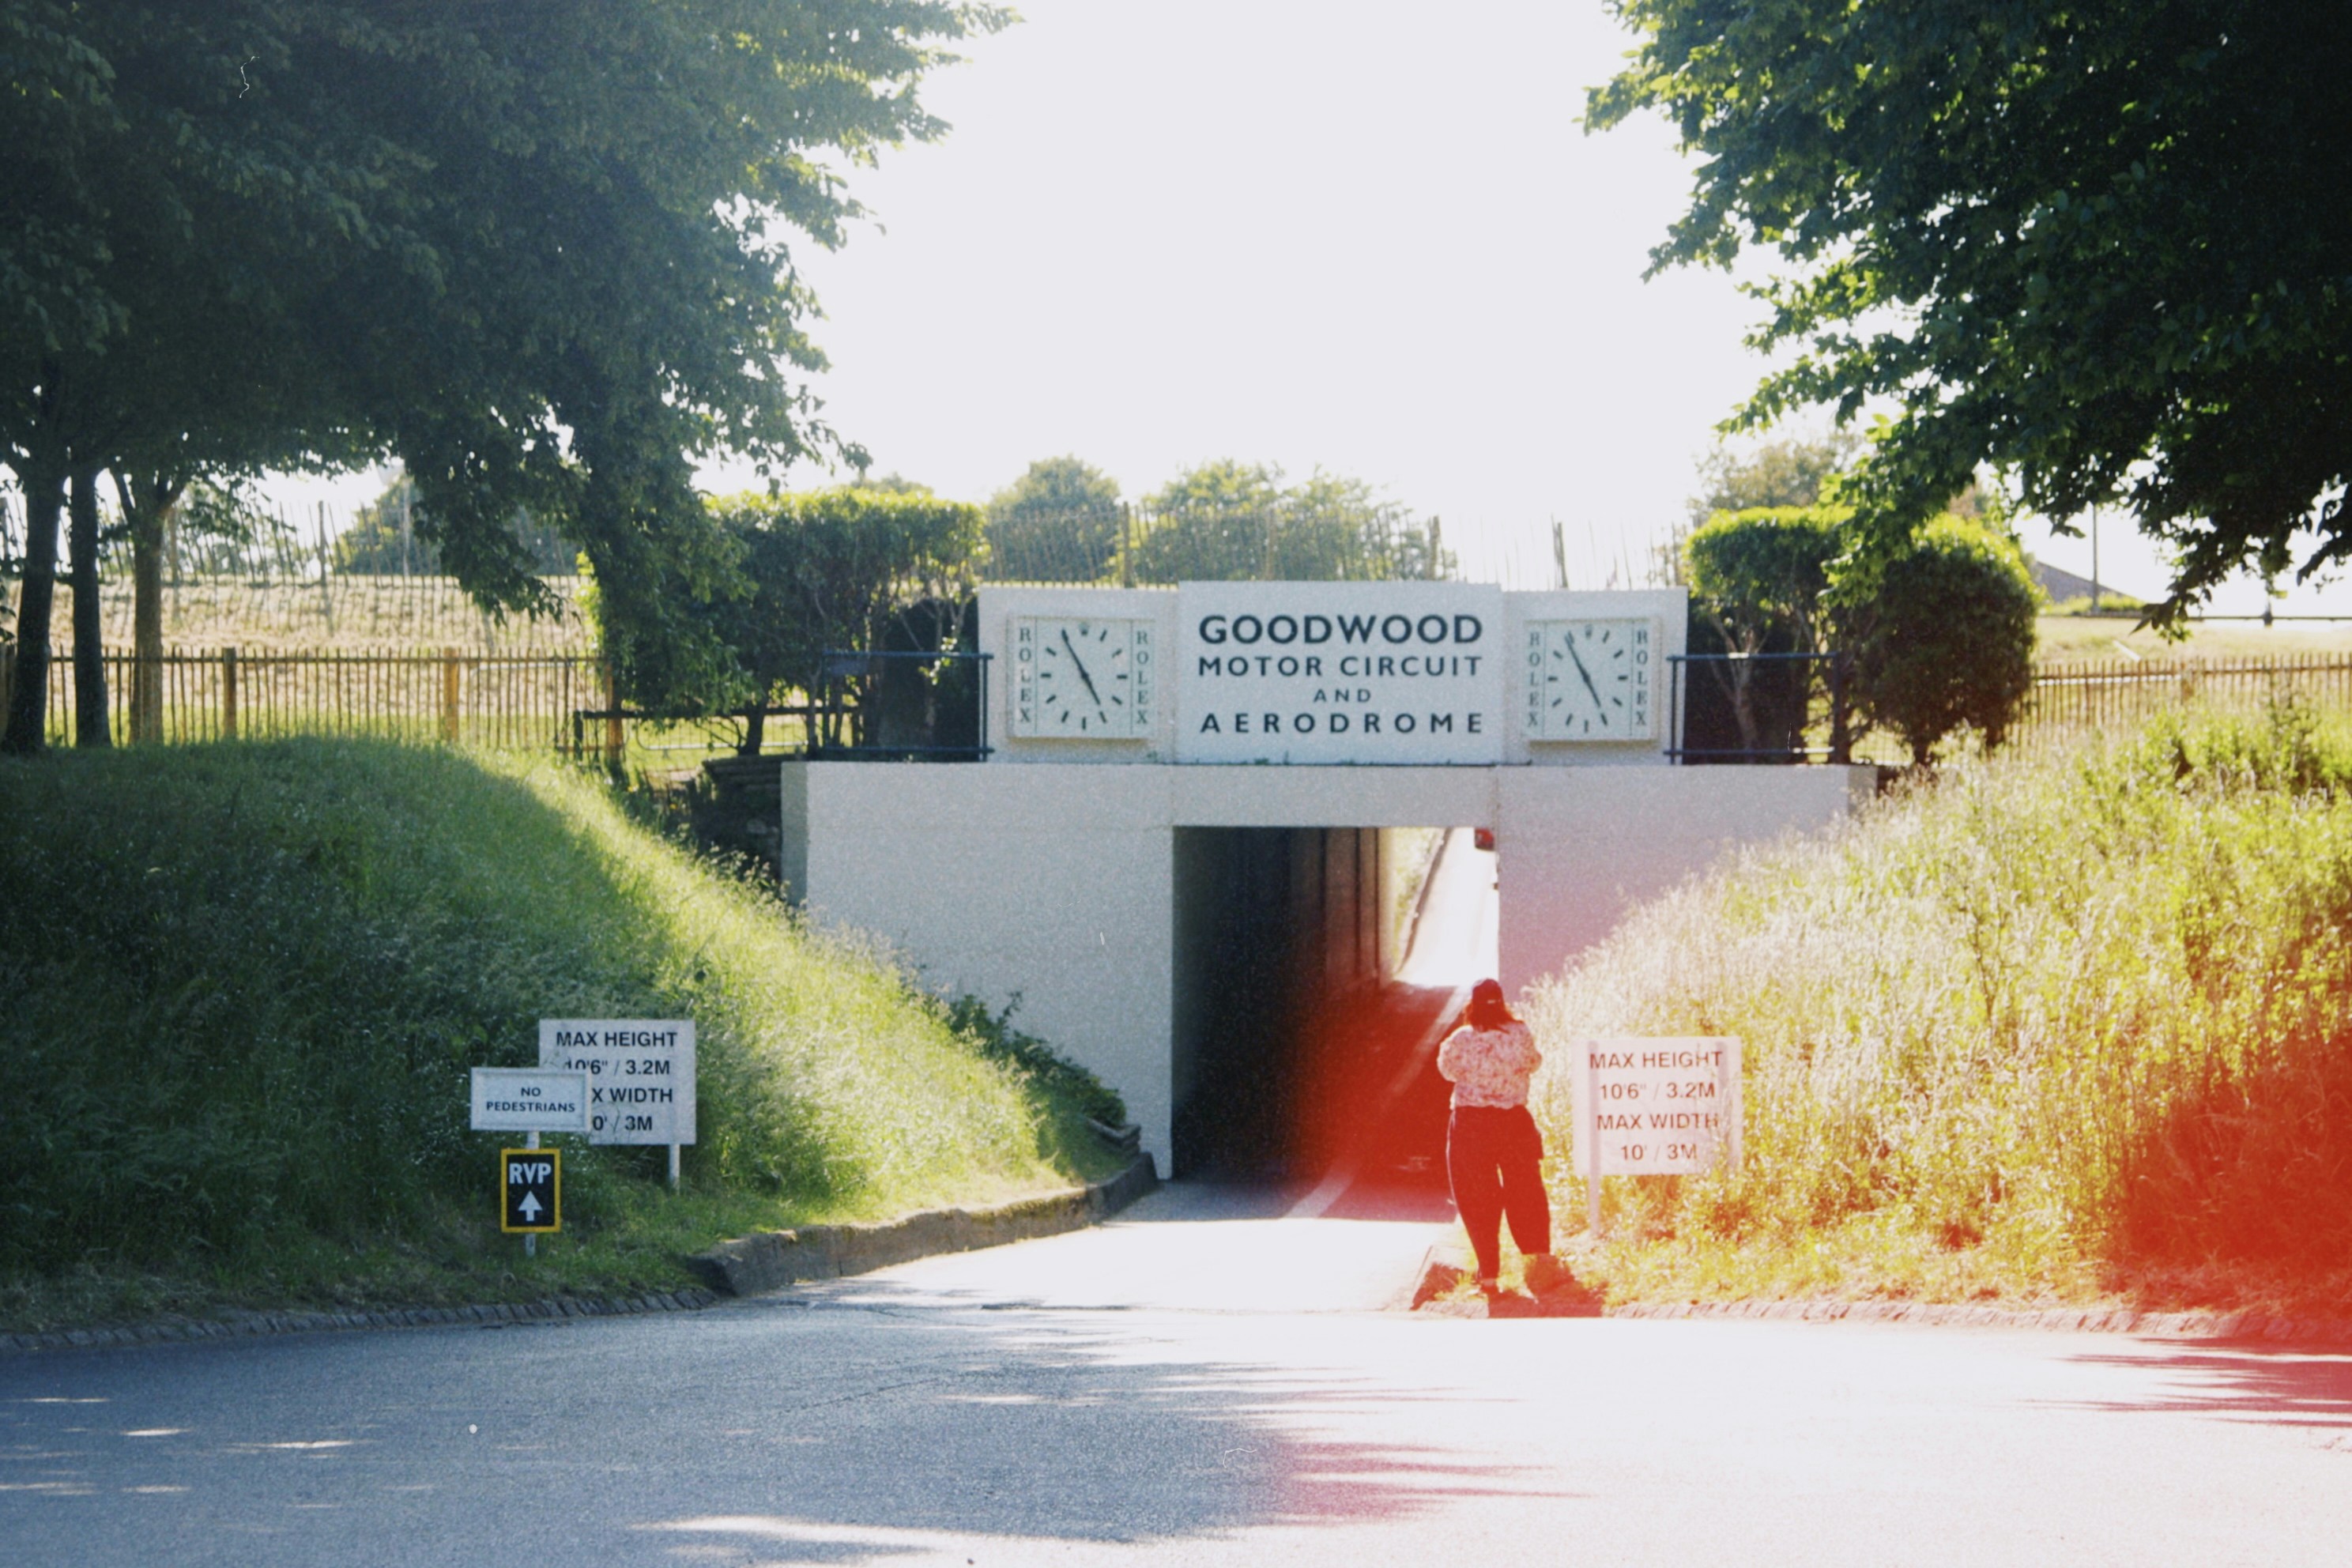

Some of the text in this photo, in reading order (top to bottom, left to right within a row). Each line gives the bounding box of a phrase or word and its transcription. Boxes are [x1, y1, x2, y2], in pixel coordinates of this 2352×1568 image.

[1198, 614, 1483, 644] GOODWOOD
[1198, 656, 1483, 677] MOTOR CIRCUIT
[1019, 628, 1031, 723] ROLEX
[1136, 631, 1149, 725] ROLEX
[1528, 631, 1540, 728] ROLEX
[1636, 630, 1648, 726] ROLEX
[1313, 688, 1372, 703] AND
[1200, 713, 1483, 733] AERODROME
[556, 1031, 678, 1047] MAX HEIGHT
[625, 1059, 670, 1075] 3.2M
[1589, 1051, 1724, 1069] MAX HEIGHT
[520, 1086, 541, 1097] NO
[609, 1087, 673, 1102] WIDTH
[1600, 1083, 1647, 1099] 10'6"
[1666, 1082, 1715, 1099] 3.2M
[485, 1101, 576, 1113] PEDESTRIANS
[624, 1115, 653, 1131] 3M
[1596, 1113, 1719, 1130] MAX WIDTH
[1621, 1144, 1648, 1161] 10'
[1666, 1144, 1698, 1160] 3M
[508, 1162, 552, 1184] RVP
